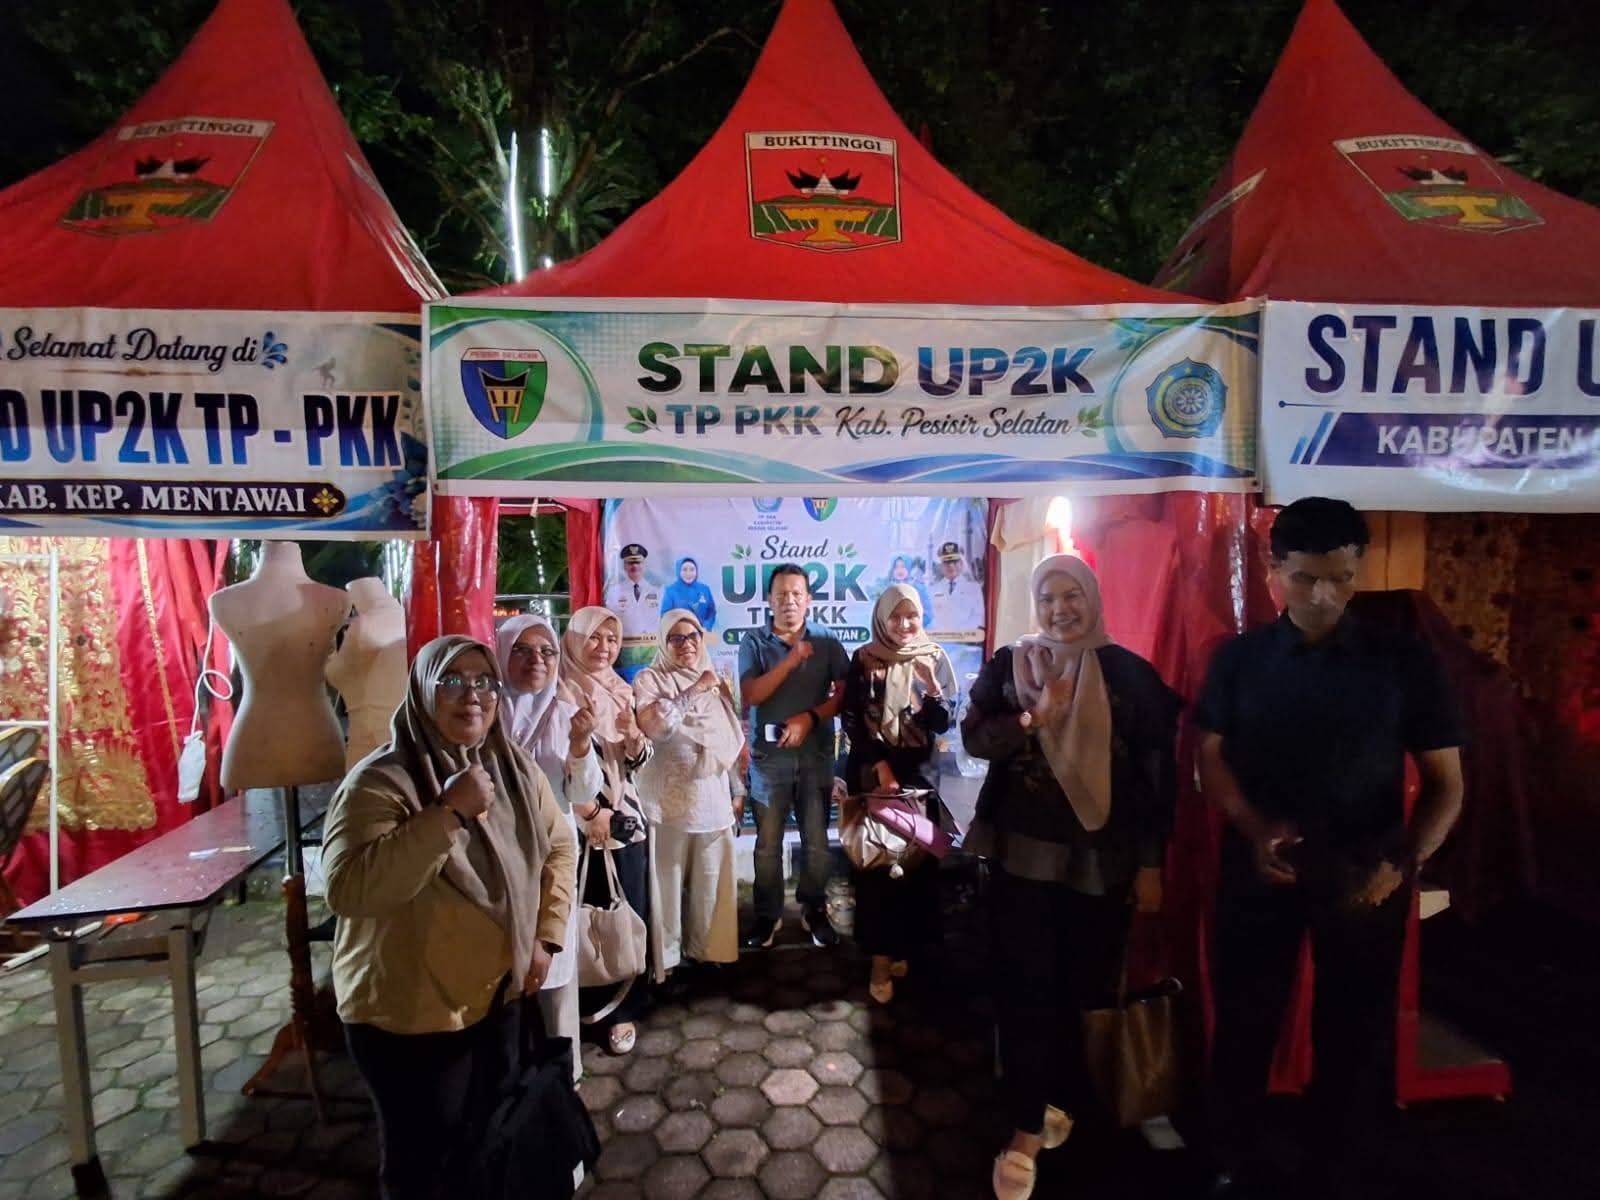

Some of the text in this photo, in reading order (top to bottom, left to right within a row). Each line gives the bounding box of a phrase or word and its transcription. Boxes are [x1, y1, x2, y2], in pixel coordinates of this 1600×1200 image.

[764, 136, 881, 151] BUKITTINGGI
[7, 326, 258, 372] Selamat Datang di
[1305, 314, 1546, 396] STAND
[638, 341, 1095, 397] STAND UP2K
[40, 389, 189, 464] UP2K
[194, 393, 260, 465] TP
[304, 394, 402, 466] PKK
[666, 405, 1072, 440] TP PKK Kab. Pesisir Selatan
[1378, 425, 1583, 455] KABUPATEN
[64, 485, 131, 510] KEP.
[141, 486, 306, 512] MENTAWAI
[760, 535, 828, 560] Stand
